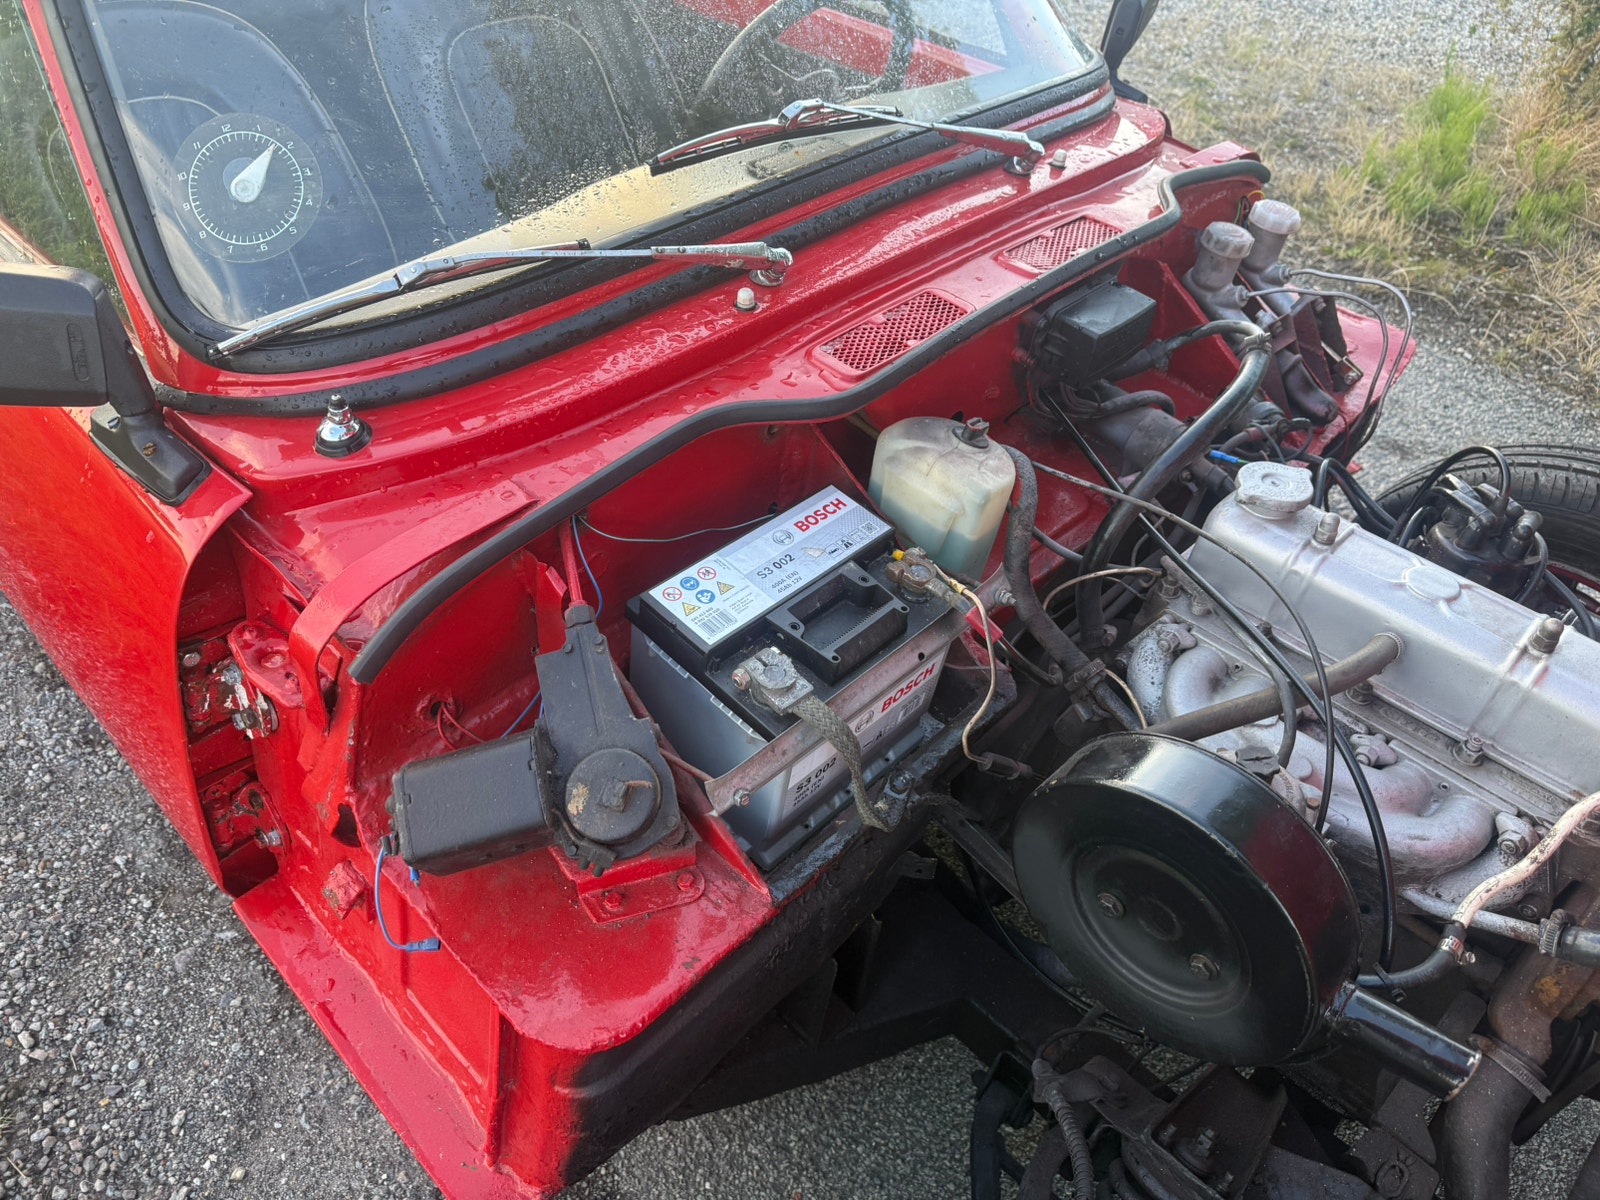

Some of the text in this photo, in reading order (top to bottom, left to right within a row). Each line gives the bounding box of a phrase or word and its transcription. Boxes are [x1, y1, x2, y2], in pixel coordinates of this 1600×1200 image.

[221, 123, 231, 132] 12
[193, 141, 201, 150] 11
[286, 141, 294, 149] 2
[177, 171, 187, 181] 10
[183, 202, 190, 211] 9
[306, 198, 313, 206] 4
[199, 230, 207, 239] 8
[289, 226, 297, 235] 5
[227, 245, 233, 254] 7
[793, 498, 848, 533] BOSCH
[757, 553, 795, 579] S3 002
[771, 570, 799, 589] 400A (EN)
[777, 583, 793, 594] 45Ah
[881, 663, 936, 713] BOSCH
[795, 757, 836, 794] S3 002
